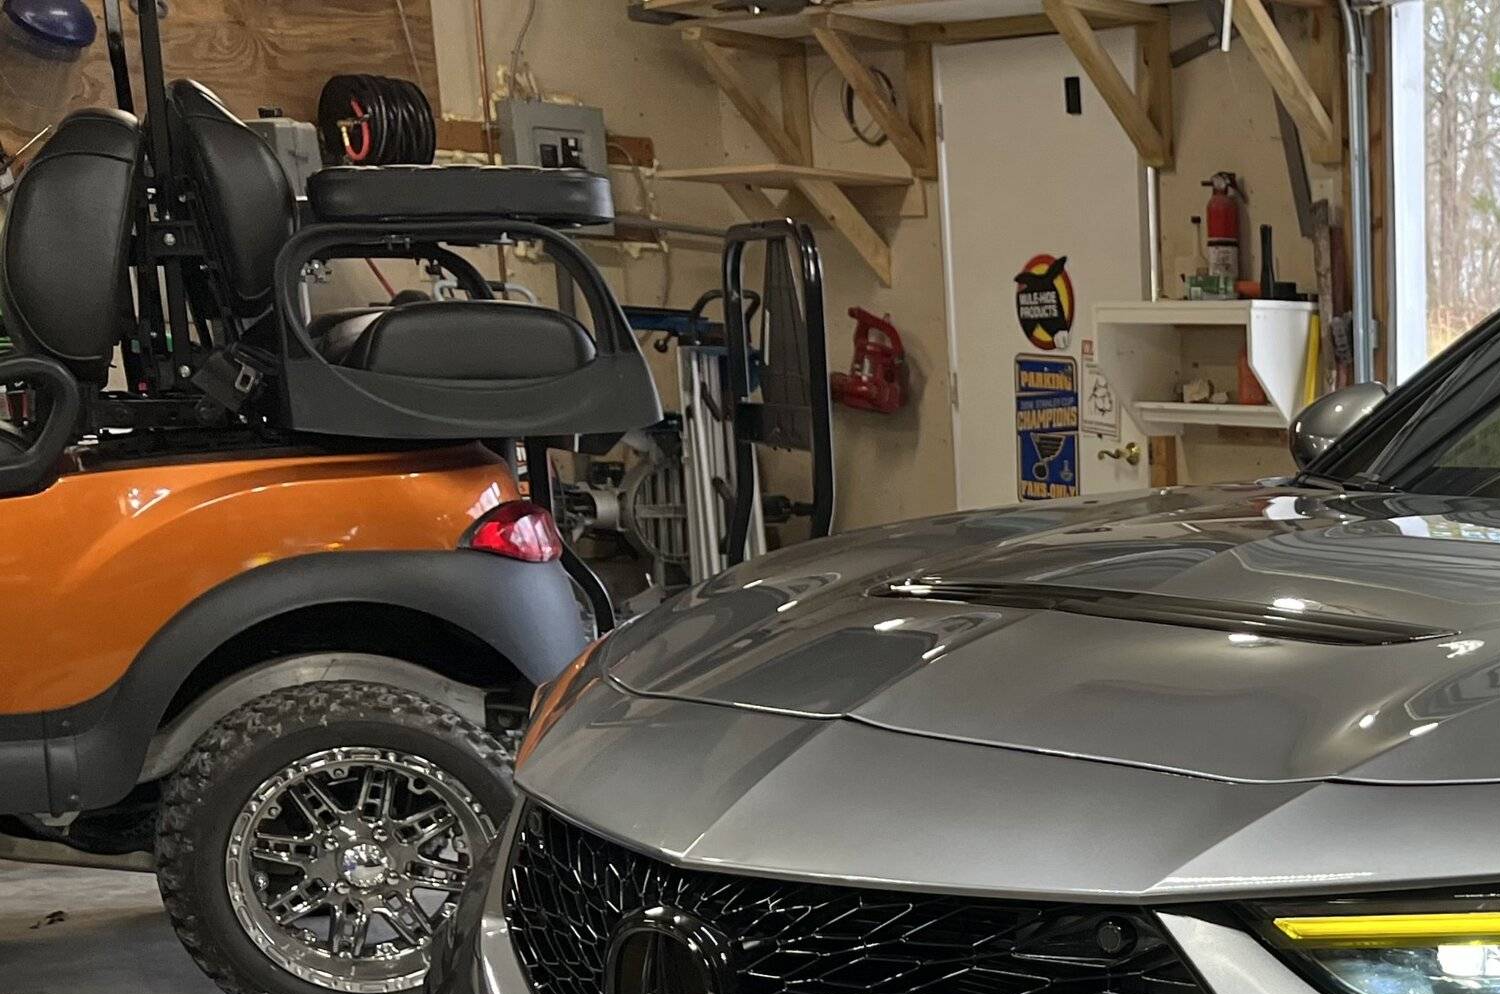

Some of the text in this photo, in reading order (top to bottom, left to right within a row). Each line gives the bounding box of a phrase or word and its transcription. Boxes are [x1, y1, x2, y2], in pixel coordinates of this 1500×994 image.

[1020, 304, 1059, 319] PRODUCTS
[1020, 371, 1073, 391] PARKING
[1017, 406, 1078, 430] CHAMPIONS
